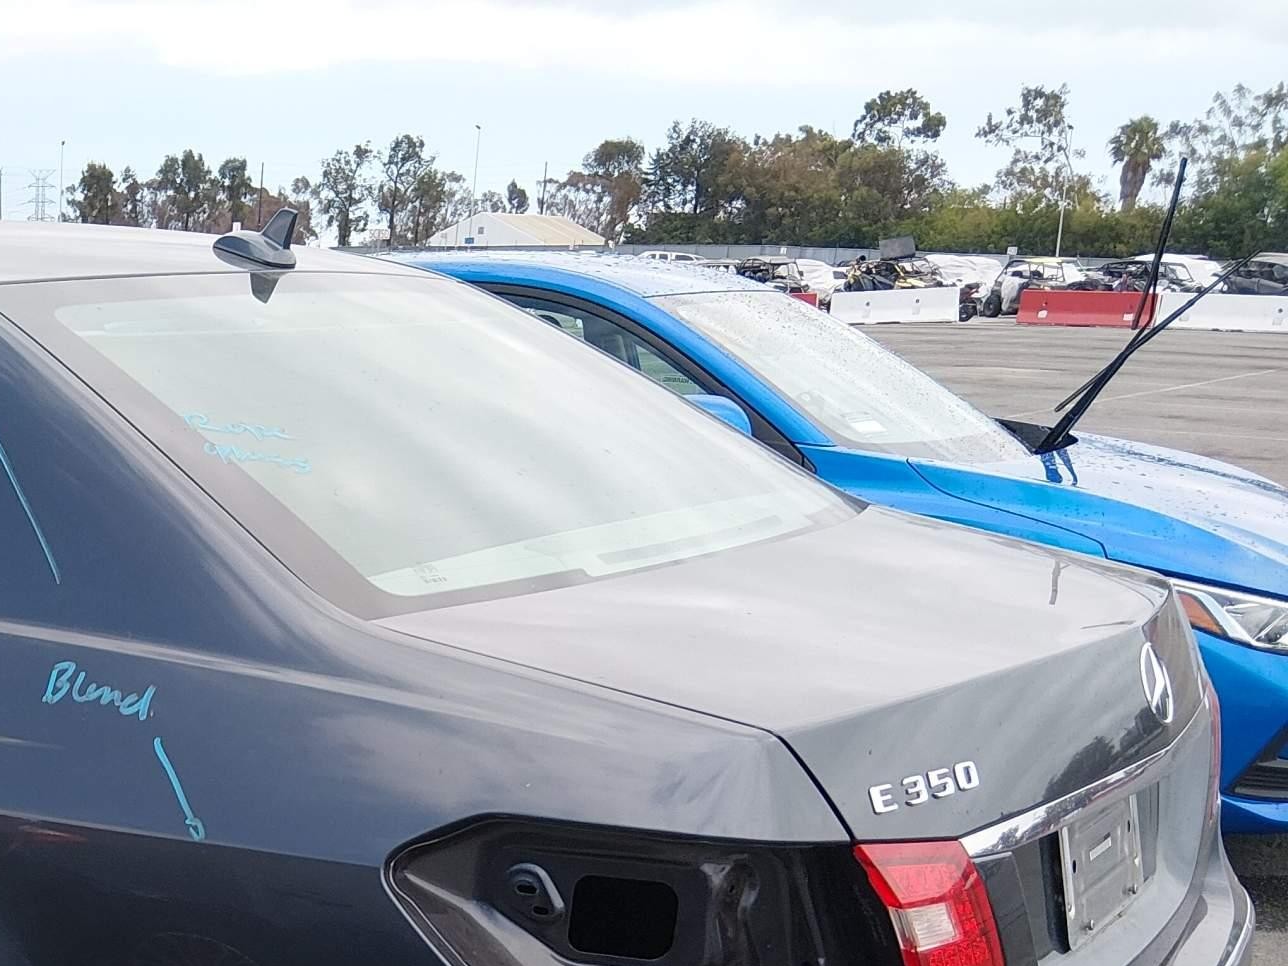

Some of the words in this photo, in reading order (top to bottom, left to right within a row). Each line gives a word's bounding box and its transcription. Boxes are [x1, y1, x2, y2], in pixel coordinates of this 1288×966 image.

[42, 661, 156, 720] Blend
[868, 783, 899, 815] E
[901, 760, 979, 807] 350
